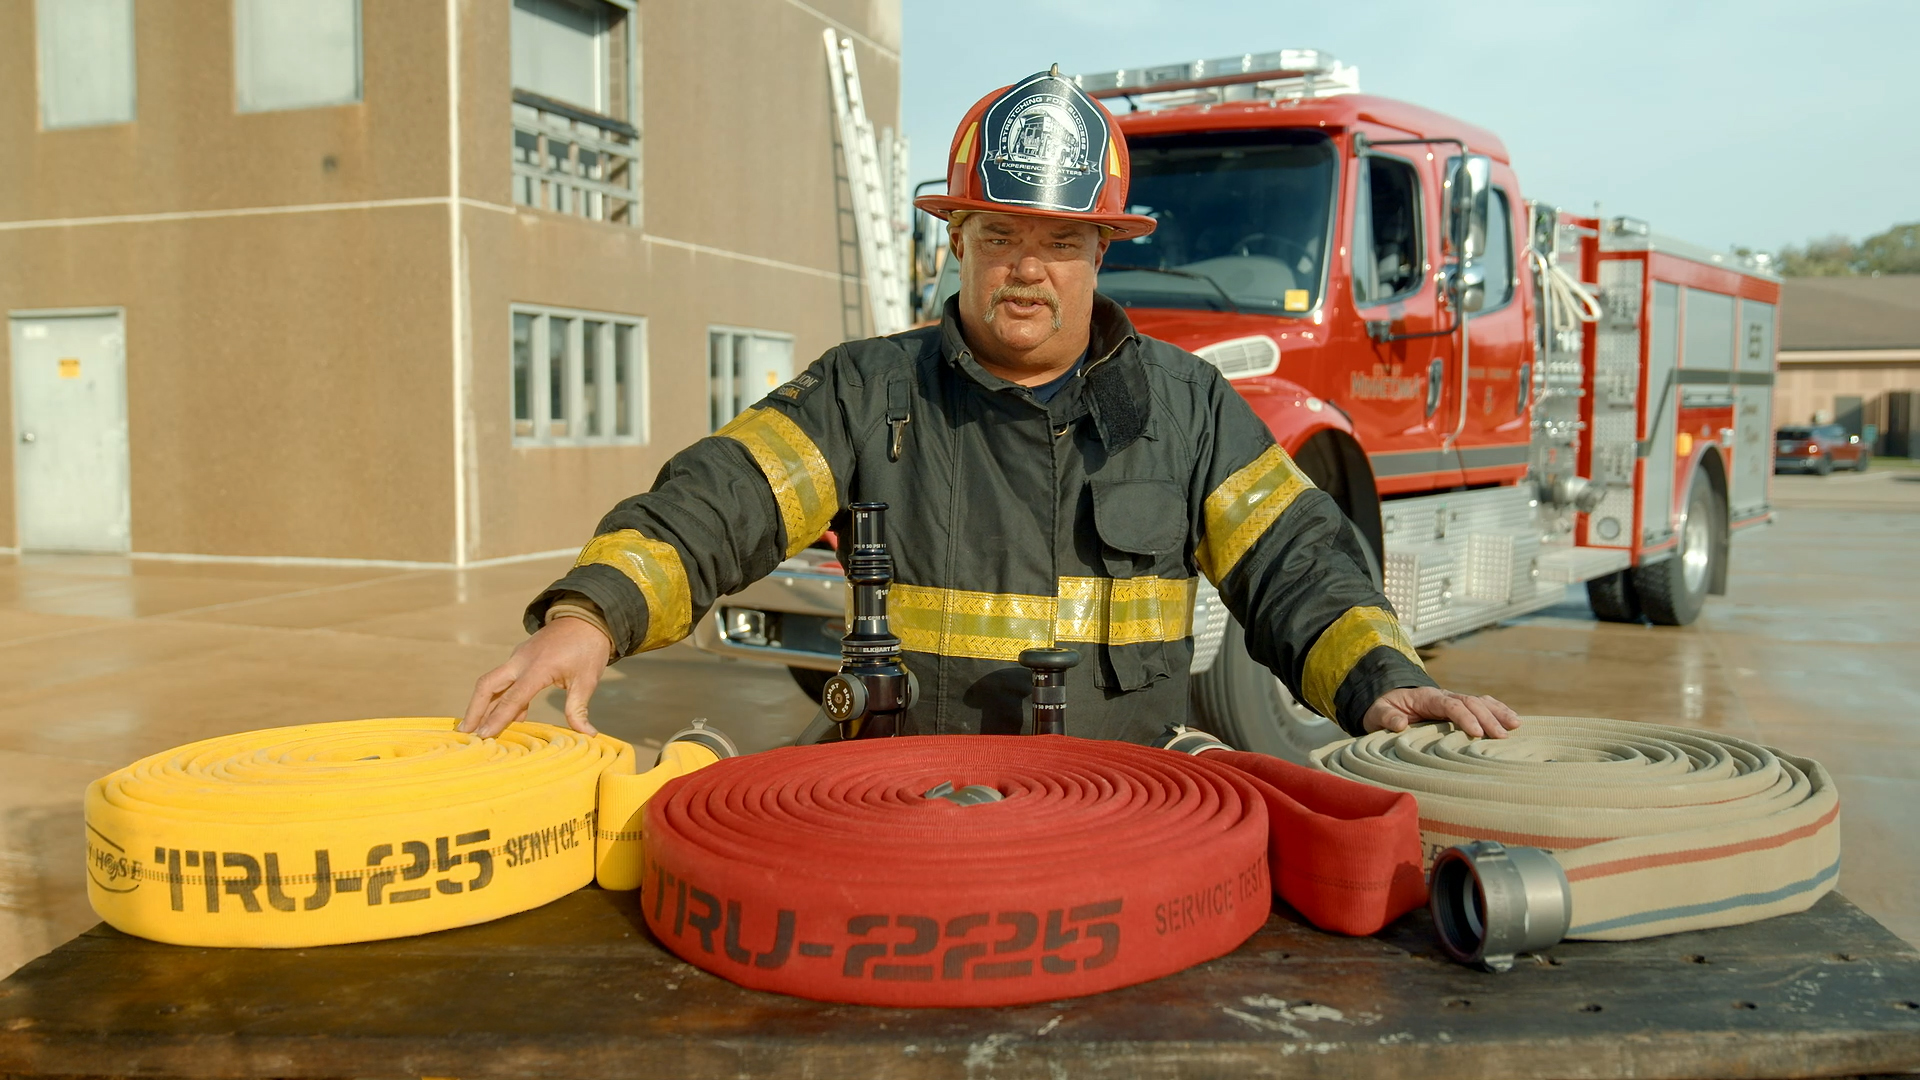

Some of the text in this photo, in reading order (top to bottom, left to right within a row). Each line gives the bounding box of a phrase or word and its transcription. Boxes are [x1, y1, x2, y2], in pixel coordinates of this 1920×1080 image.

[1001, 96, 1087, 150] STRETCHING FOR SUCCESS
[1052, 166, 1082, 176] ATTERS
[862, 645, 891, 653] ELKHART
[826, 682, 850, 714] ELKHART BRASS
[154, 829, 494, 914] TRU-25
[504, 818, 579, 868] SERVICE
[651, 860, 1123, 981] TRU-225
[1155, 878, 1234, 936] SERVICE
